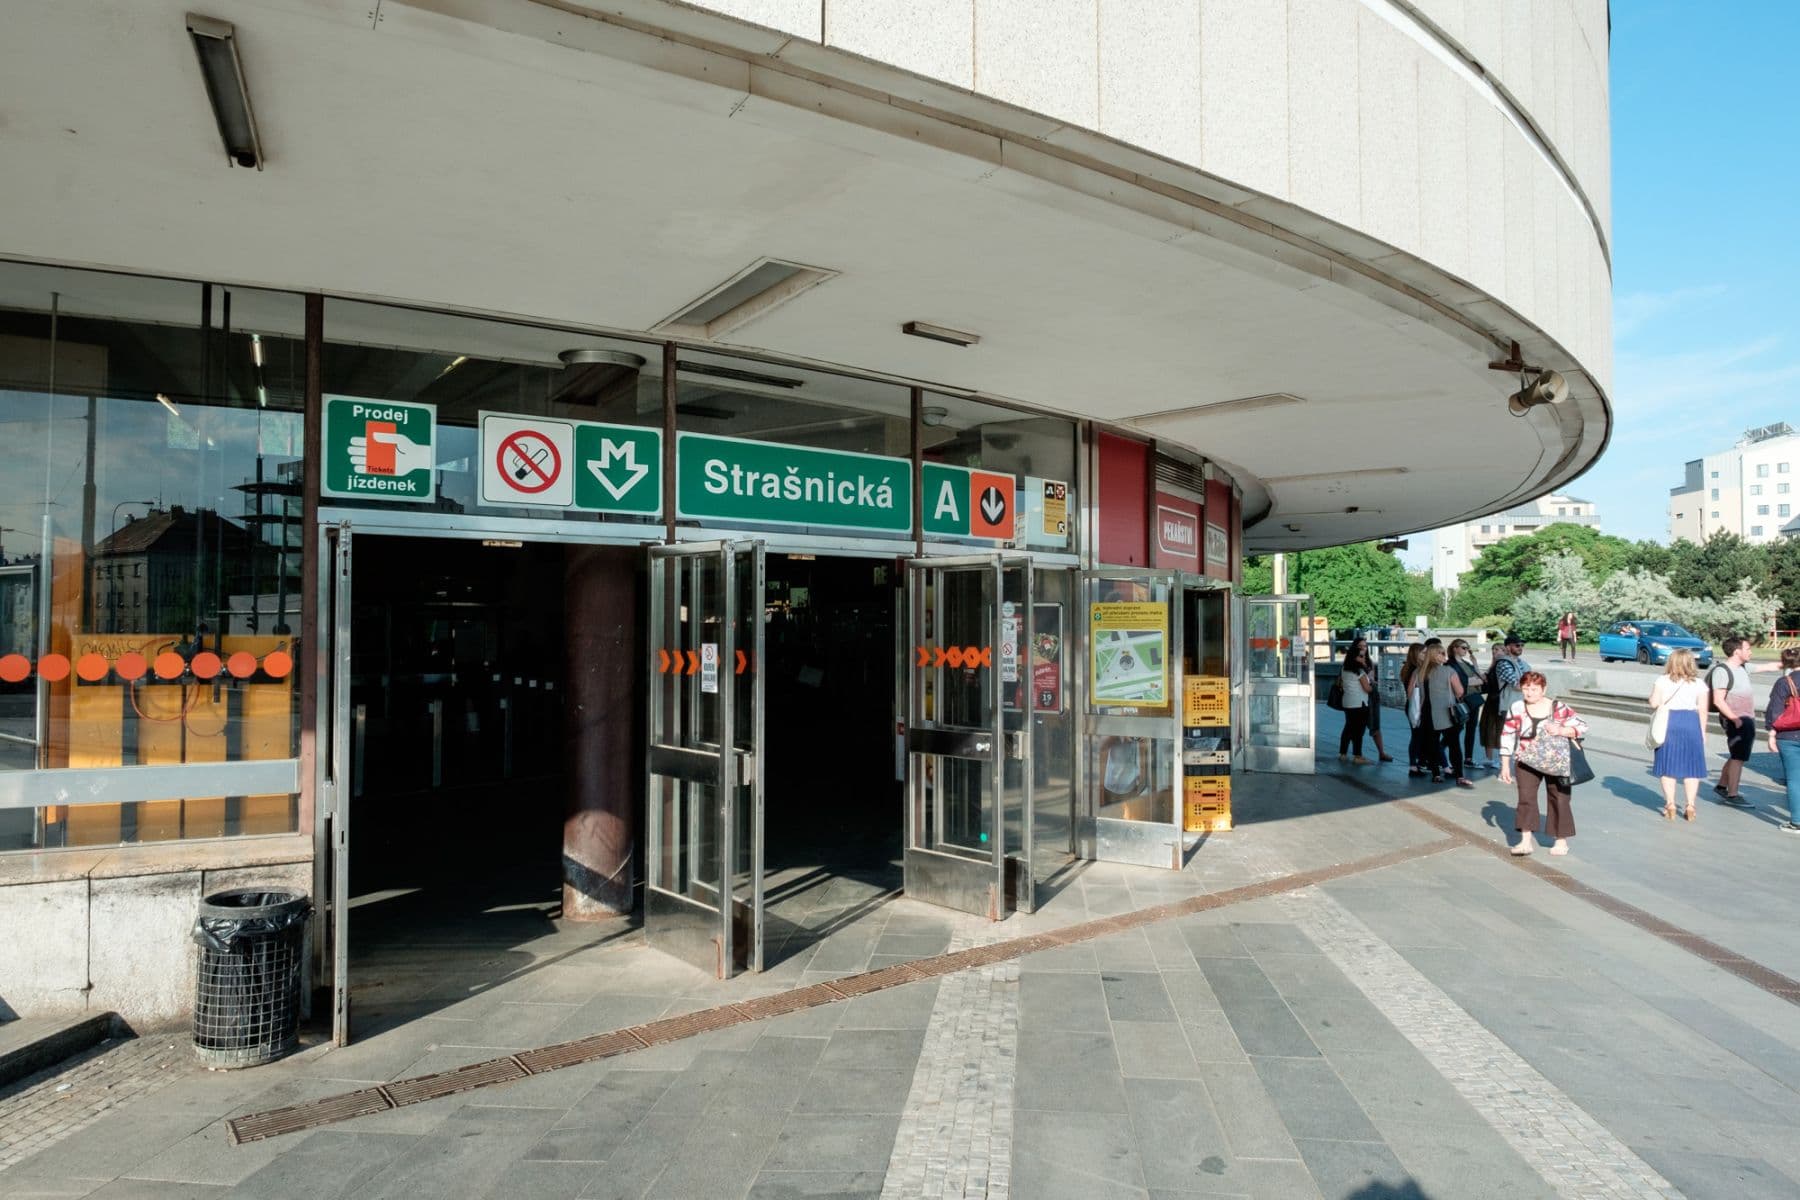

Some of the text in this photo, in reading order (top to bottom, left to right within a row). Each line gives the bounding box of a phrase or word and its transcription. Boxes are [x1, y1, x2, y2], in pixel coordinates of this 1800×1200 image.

[353, 405, 408, 424] Prodej
[367, 465, 394, 474] Tickets
[347, 475, 416, 491] jízdenek
[704, 459, 893, 508] Strašnická
[934, 479, 960, 522] A
